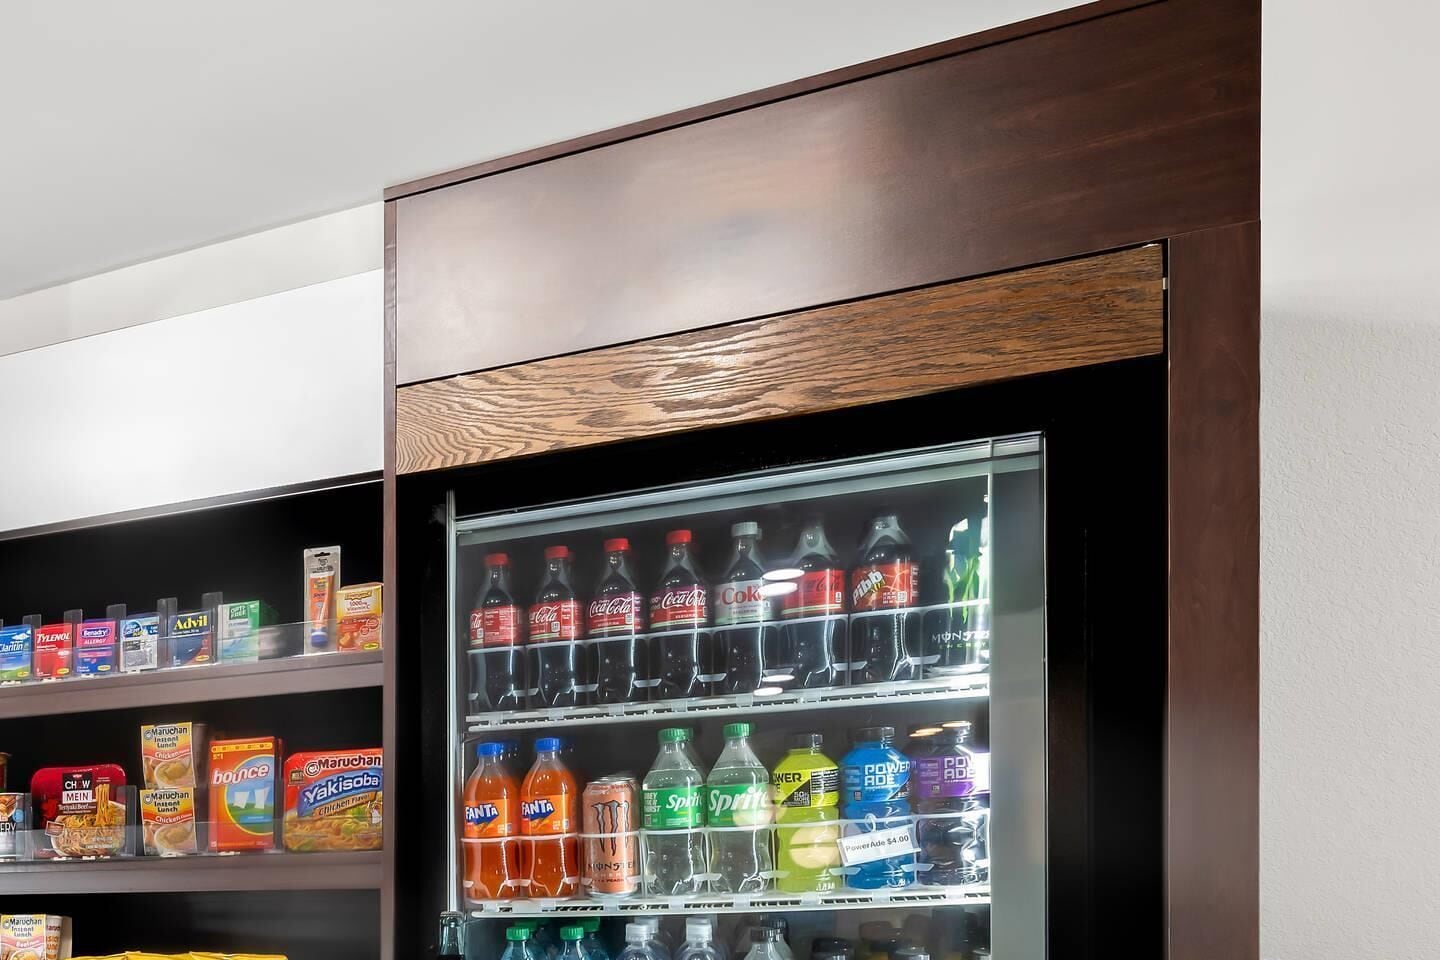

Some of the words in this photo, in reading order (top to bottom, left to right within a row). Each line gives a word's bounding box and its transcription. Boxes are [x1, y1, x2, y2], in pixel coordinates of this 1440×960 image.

[853, 570, 883, 606] Pibb
[662, 589, 707, 609] Coca-Cola
[590, 597, 631, 618] Coca-Cola
[174, 615, 208, 630] Advil
[36, 632, 70, 643] TYLENOL
[151, 726, 187, 736] Maruchan
[154, 751, 179, 759] Chicken
[319, 756, 381, 769] Maruchan
[213, 764, 269, 785] bounce
[865, 761, 910, 774] POWER
[305, 773, 379, 802] Yakisoba
[865, 775, 895, 786] ADE
[66, 791, 89, 801] MEIN
[151, 791, 189, 799] Maruchan
[319, 799, 350, 815] Chicken
[351, 794, 370, 806] Flavor
[465, 803, 498, 820] FANTA
[521, 800, 554, 816] FANTA
[845, 839, 885, 852] PowerAde
[887, 835, 909, 845] $4.00
